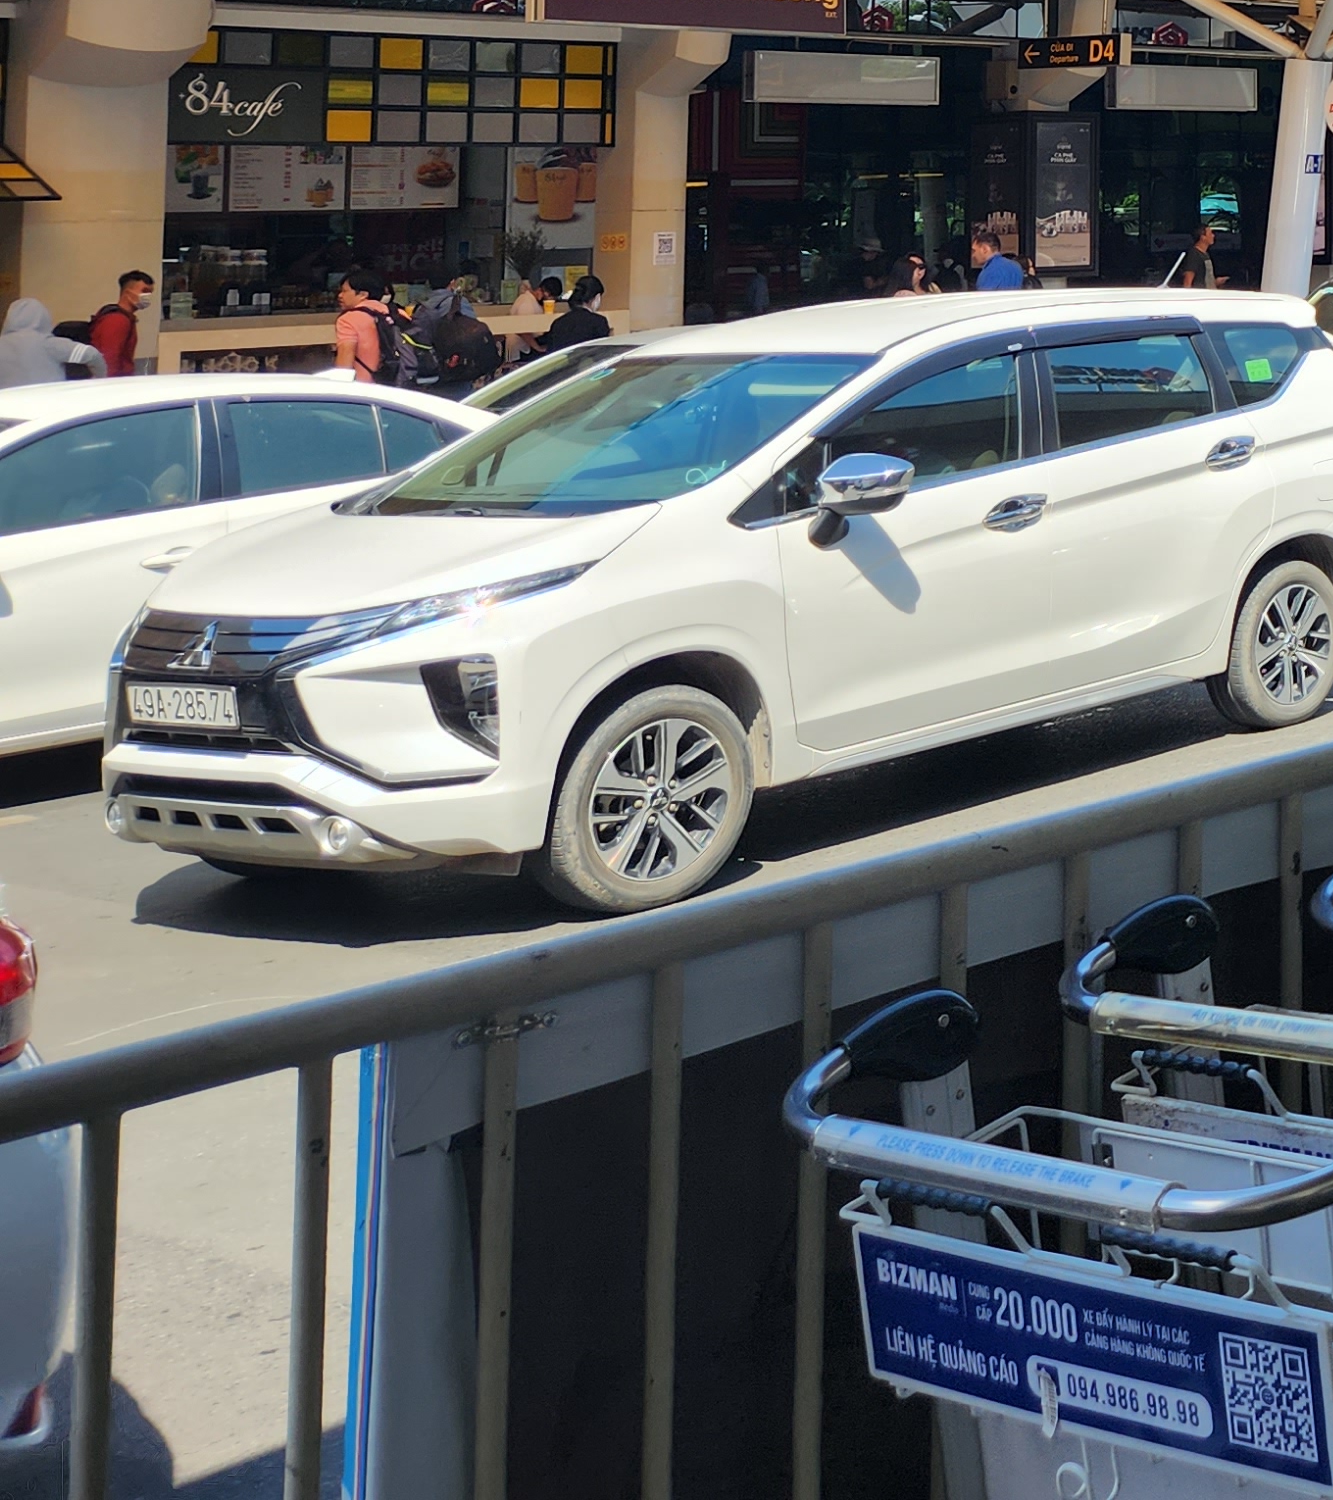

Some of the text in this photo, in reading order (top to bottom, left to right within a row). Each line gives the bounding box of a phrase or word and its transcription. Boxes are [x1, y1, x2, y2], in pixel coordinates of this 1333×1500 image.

[1089, 39, 1115, 63] D4
[185, 73, 302, 137] 84 café
[875, 1133, 914, 1154] PLEASE
[915, 1141, 944, 1161] PRESS
[978, 1153, 992, 1168] TO
[992, 1156, 1040, 1178] RELEASE
[1040, 1165, 1057, 1182] THE
[1057, 1169, 1096, 1189] BRAKE
[876, 1257, 958, 1301] BIZMAN
[968, 1281, 1079, 1344] CUNG 20.000
[975, 1300, 992, 1322] CẤP
[1082, 1308, 1094, 1324] XE
[1115, 1314, 1141, 1335] HÀNH
[1142, 1319, 1152, 1337] LÝ
[1154, 1324, 1170, 1343] TẠI
[1171, 1325, 1190, 1346] CÁC
[885, 1326, 1018, 1386] LIÊN HỆ QUẢNG CÁO
[1084, 1328, 1207, 1372] CẢNG HÀNG KHÔNG QUỐC TẾ
[1067, 1373, 1200, 1427] 094.986.98.98
